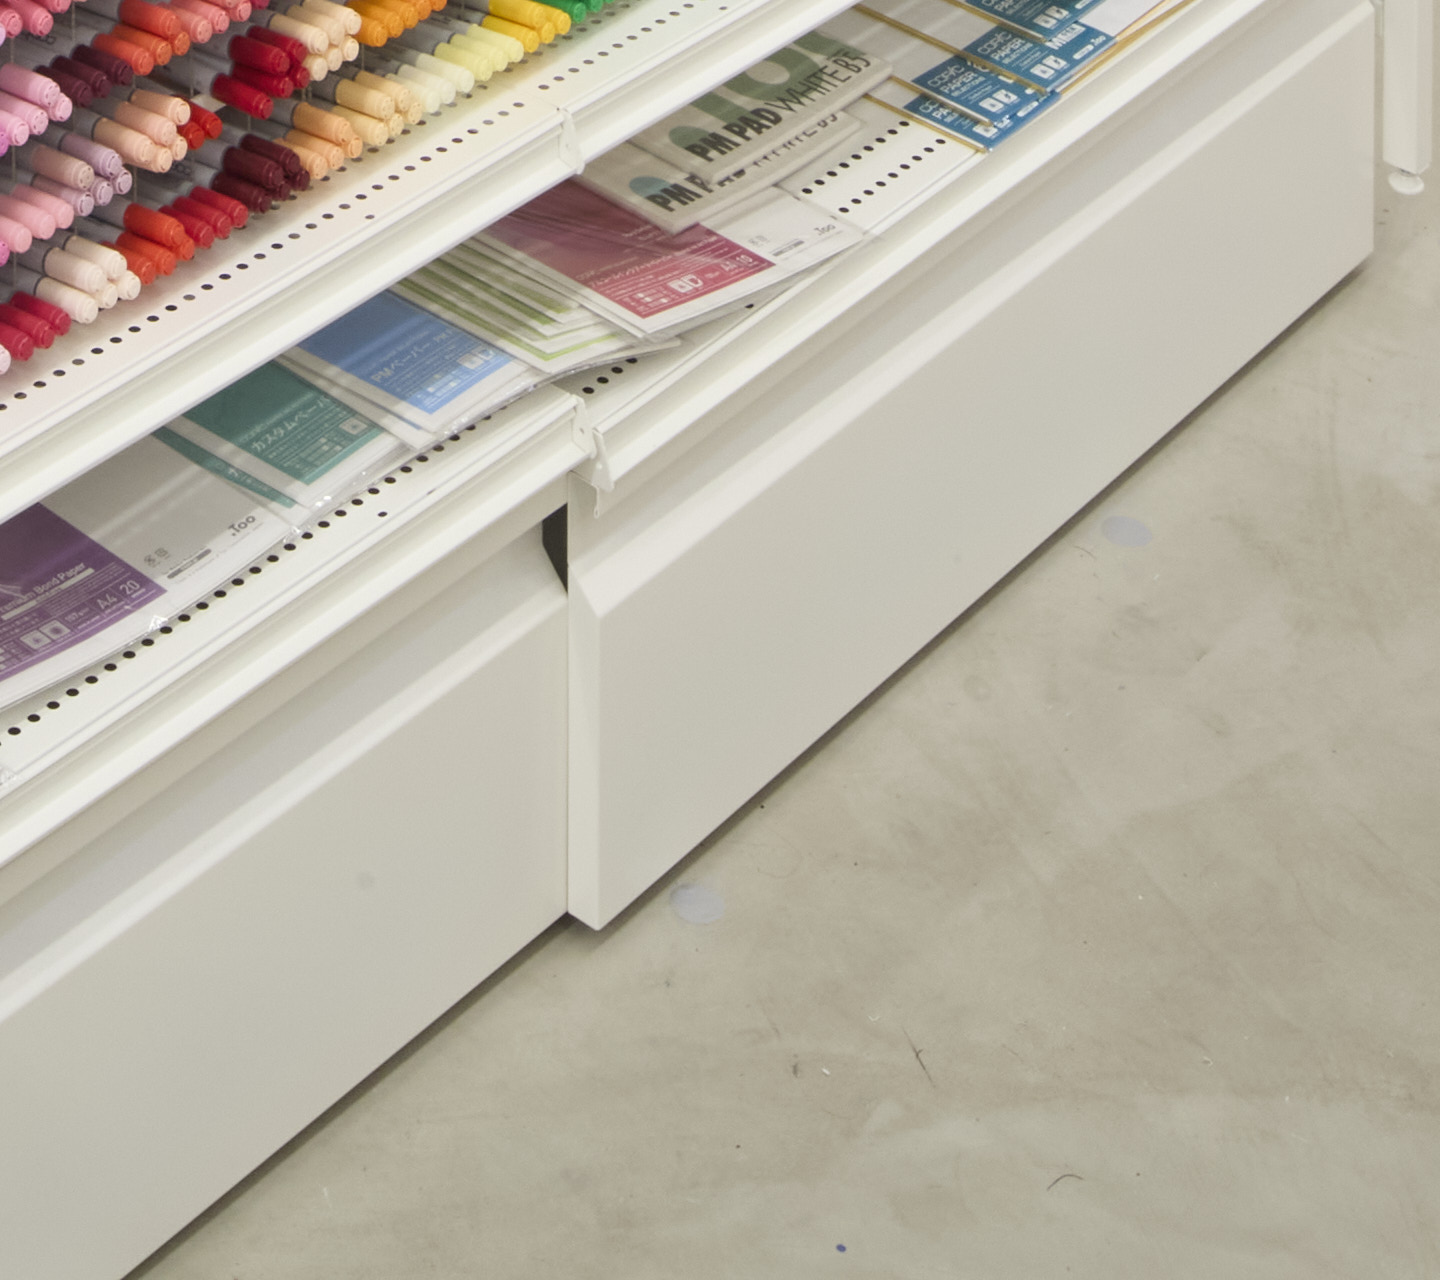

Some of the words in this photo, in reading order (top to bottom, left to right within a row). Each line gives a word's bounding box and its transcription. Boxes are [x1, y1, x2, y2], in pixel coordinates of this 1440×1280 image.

[682, 128, 735, 164] PM
[728, 106, 784, 143] PAD
[763, 64, 853, 115] WHITE
[839, 50, 872, 81] B5
[645, 179, 704, 213] PM
[35, 576, 60, 597] Bond
[58, 561, 88, 586] Paper
[96, 592, 120, 612] A4
[120, 578, 142, 598] 20
